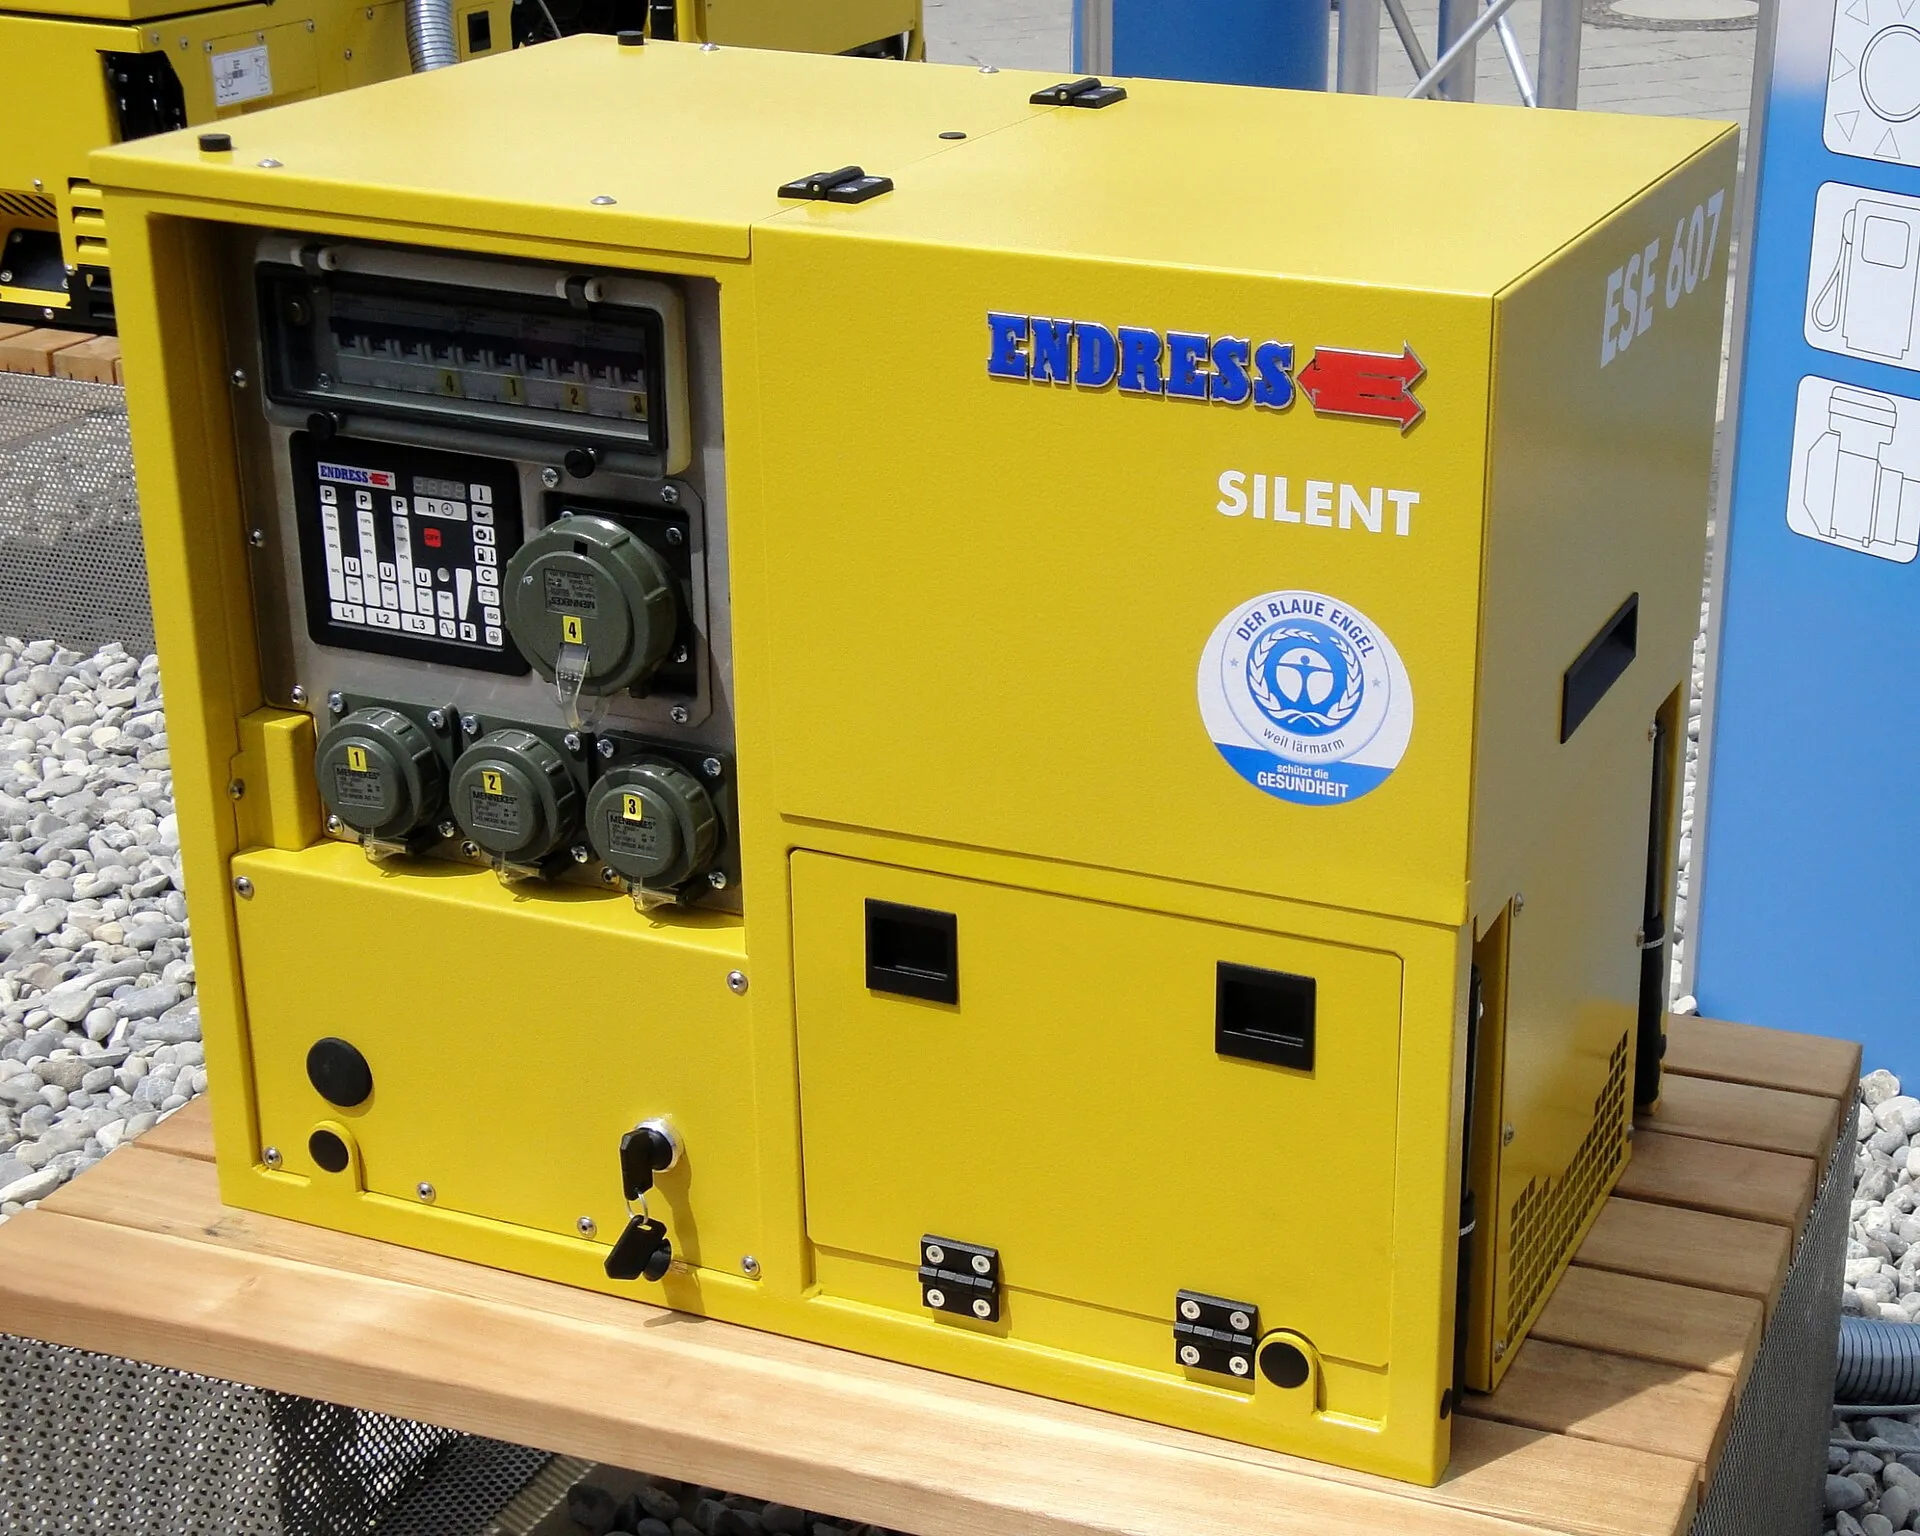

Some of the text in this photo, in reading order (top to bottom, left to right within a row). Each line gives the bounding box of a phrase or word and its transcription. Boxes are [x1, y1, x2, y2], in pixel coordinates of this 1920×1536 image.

[1601, 189, 1725, 369] ESE 607
[987, 310, 1296, 411] ENDRESS
[446, 375, 454, 392] 4
[510, 379, 517, 396] 1
[570, 388, 579, 405] 2
[633, 395, 643, 413] 3
[320, 465, 369, 484] ENDRESS
[324, 490, 332, 500] P
[360, 495, 368, 505] P
[396, 500, 403, 511] P
[428, 502, 436, 512] h
[1216, 470, 1421, 537] SILENT
[348, 561, 356, 572] U
[384, 566, 392, 577] U
[419, 572, 427, 583] U
[342, 607, 354, 618] L1
[376, 612, 390, 624] L2
[487, 612, 498, 620] ISO
[412, 618, 426, 630] L3
[568, 621, 577, 639] 4
[1236, 598, 1375, 659] DER BLAUE ENGEL
[1263, 727, 1345, 755] weil lärmarm
[353, 751, 360, 767] 1
[1276, 763, 1329, 780] schützt die
[488, 774, 497, 790] 2
[1257, 771, 1349, 798] GESUNDHEIT
[628, 798, 636, 814] 3
